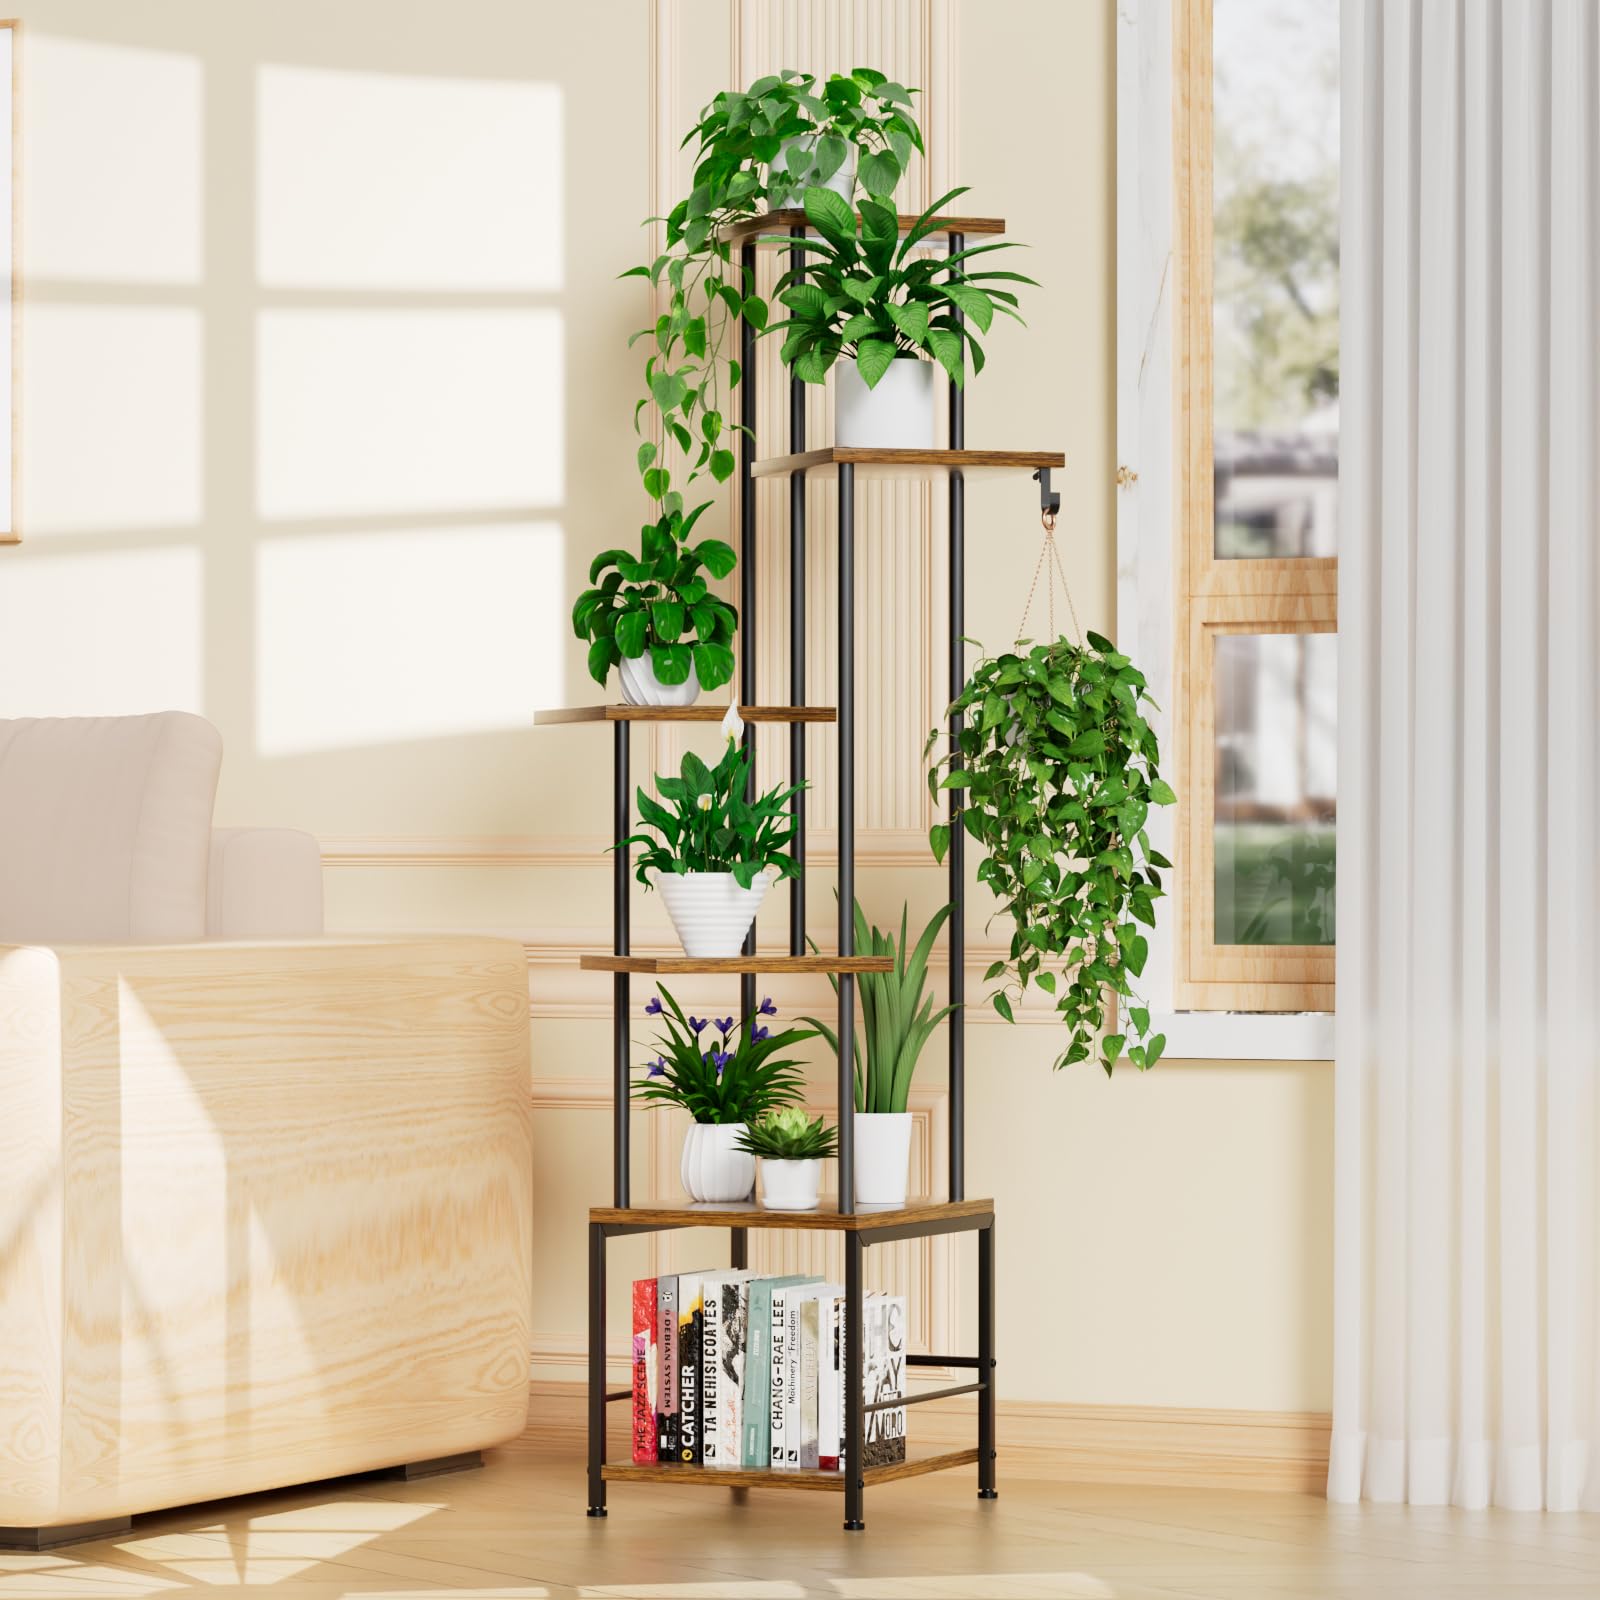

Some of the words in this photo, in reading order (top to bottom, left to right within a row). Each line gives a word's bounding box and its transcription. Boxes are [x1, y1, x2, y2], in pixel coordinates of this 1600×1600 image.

[704, 1299, 717, 1357] COATES
[772, 1299, 784, 1328] LEE
[787, 1310, 796, 1351] Freedom
[636, 1349, 646, 1390] SCENE
[772, 1335, 784, 1430] CHANG-RAE
[787, 1359, 797, 1405] Machinery
[636, 1391, 646, 1423] JAZZ
[681, 1365, 695, 1447] CATCHER
[636, 1425, 646, 1451] THE
